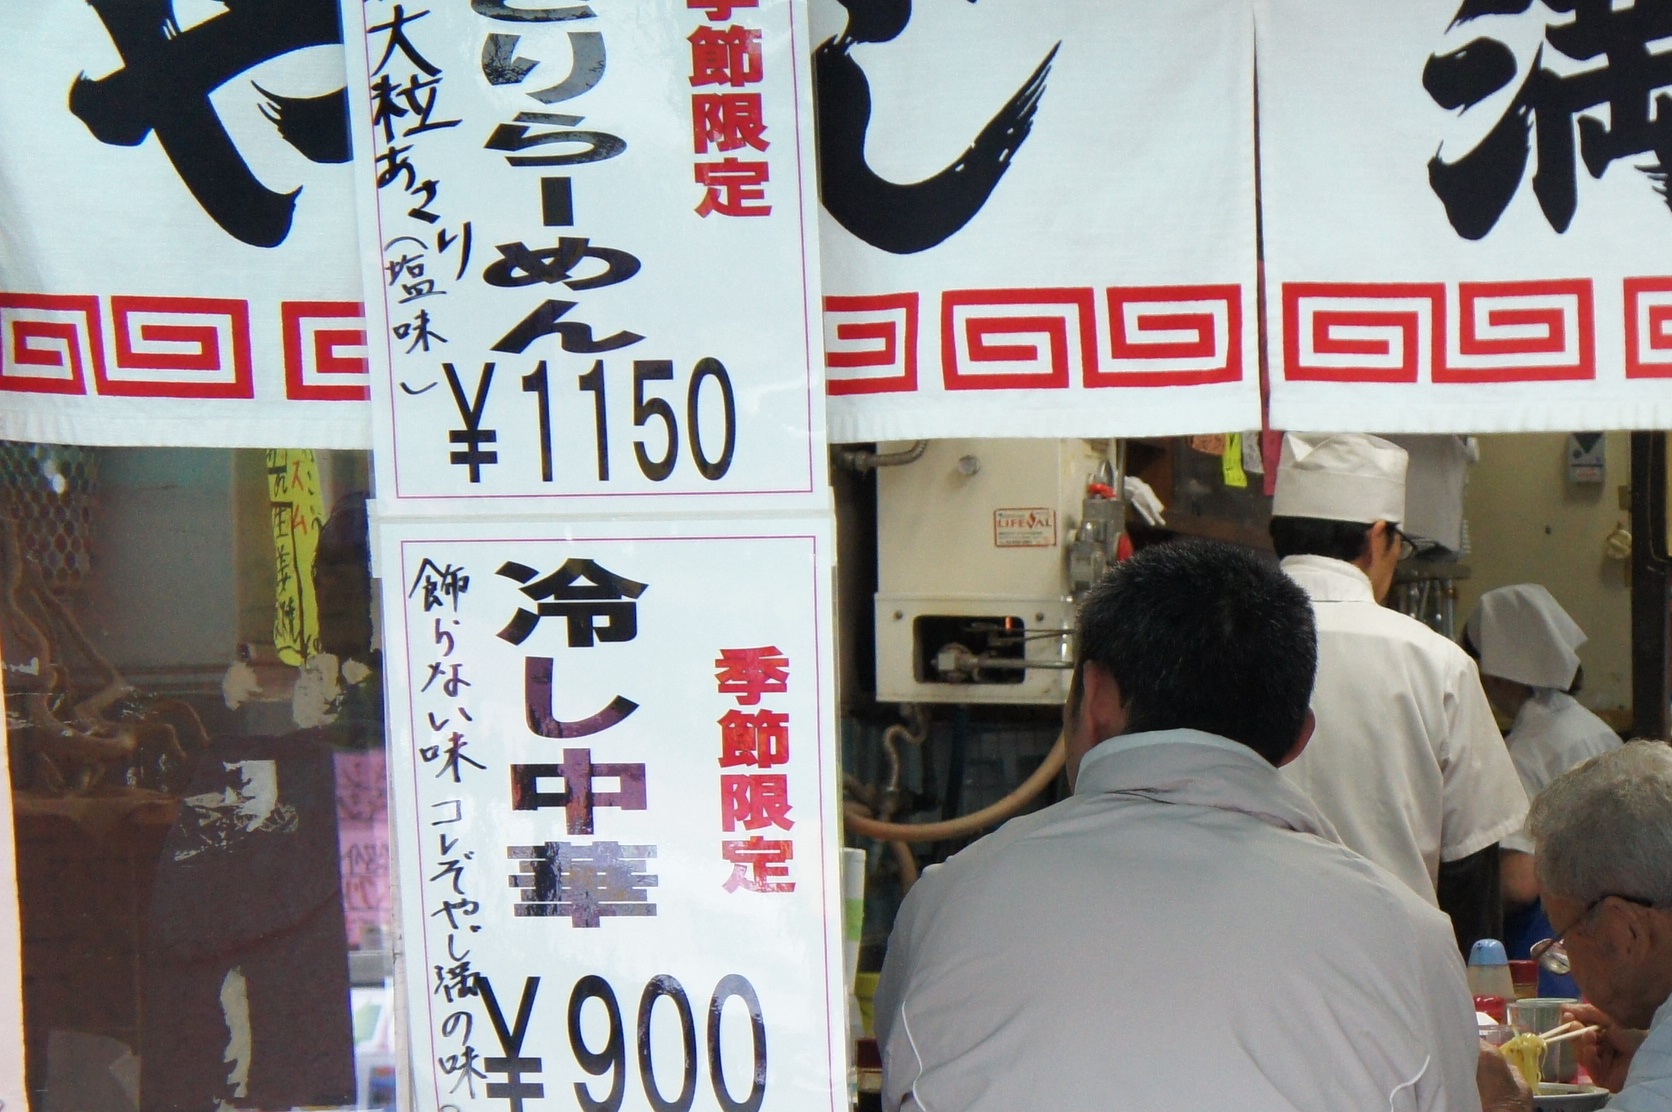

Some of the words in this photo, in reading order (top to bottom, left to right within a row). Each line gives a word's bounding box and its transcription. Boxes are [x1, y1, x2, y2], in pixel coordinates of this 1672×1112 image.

[441, 357, 736, 483] ¥1150
[495, 558, 661, 928] 冷し中華
[715, 646, 797, 894] 季節限定
